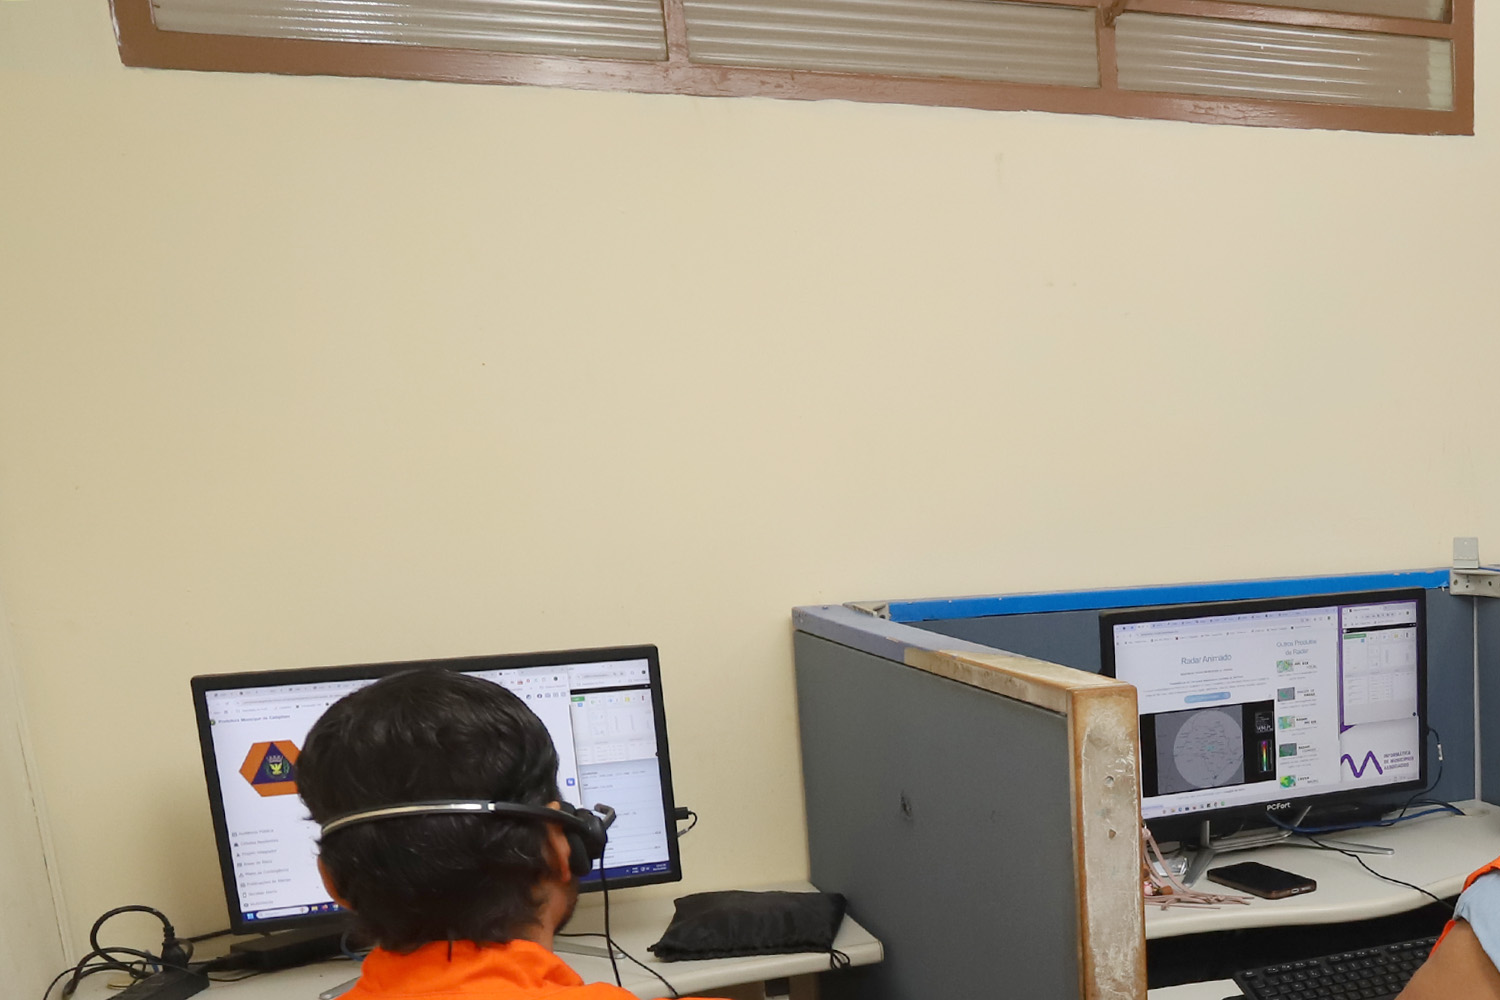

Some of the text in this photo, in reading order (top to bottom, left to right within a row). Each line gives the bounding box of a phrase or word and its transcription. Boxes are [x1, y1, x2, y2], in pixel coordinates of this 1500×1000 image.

[1181, 654, 1232, 665] Radar Animado
[1266, 802, 1291, 811] PCFort
